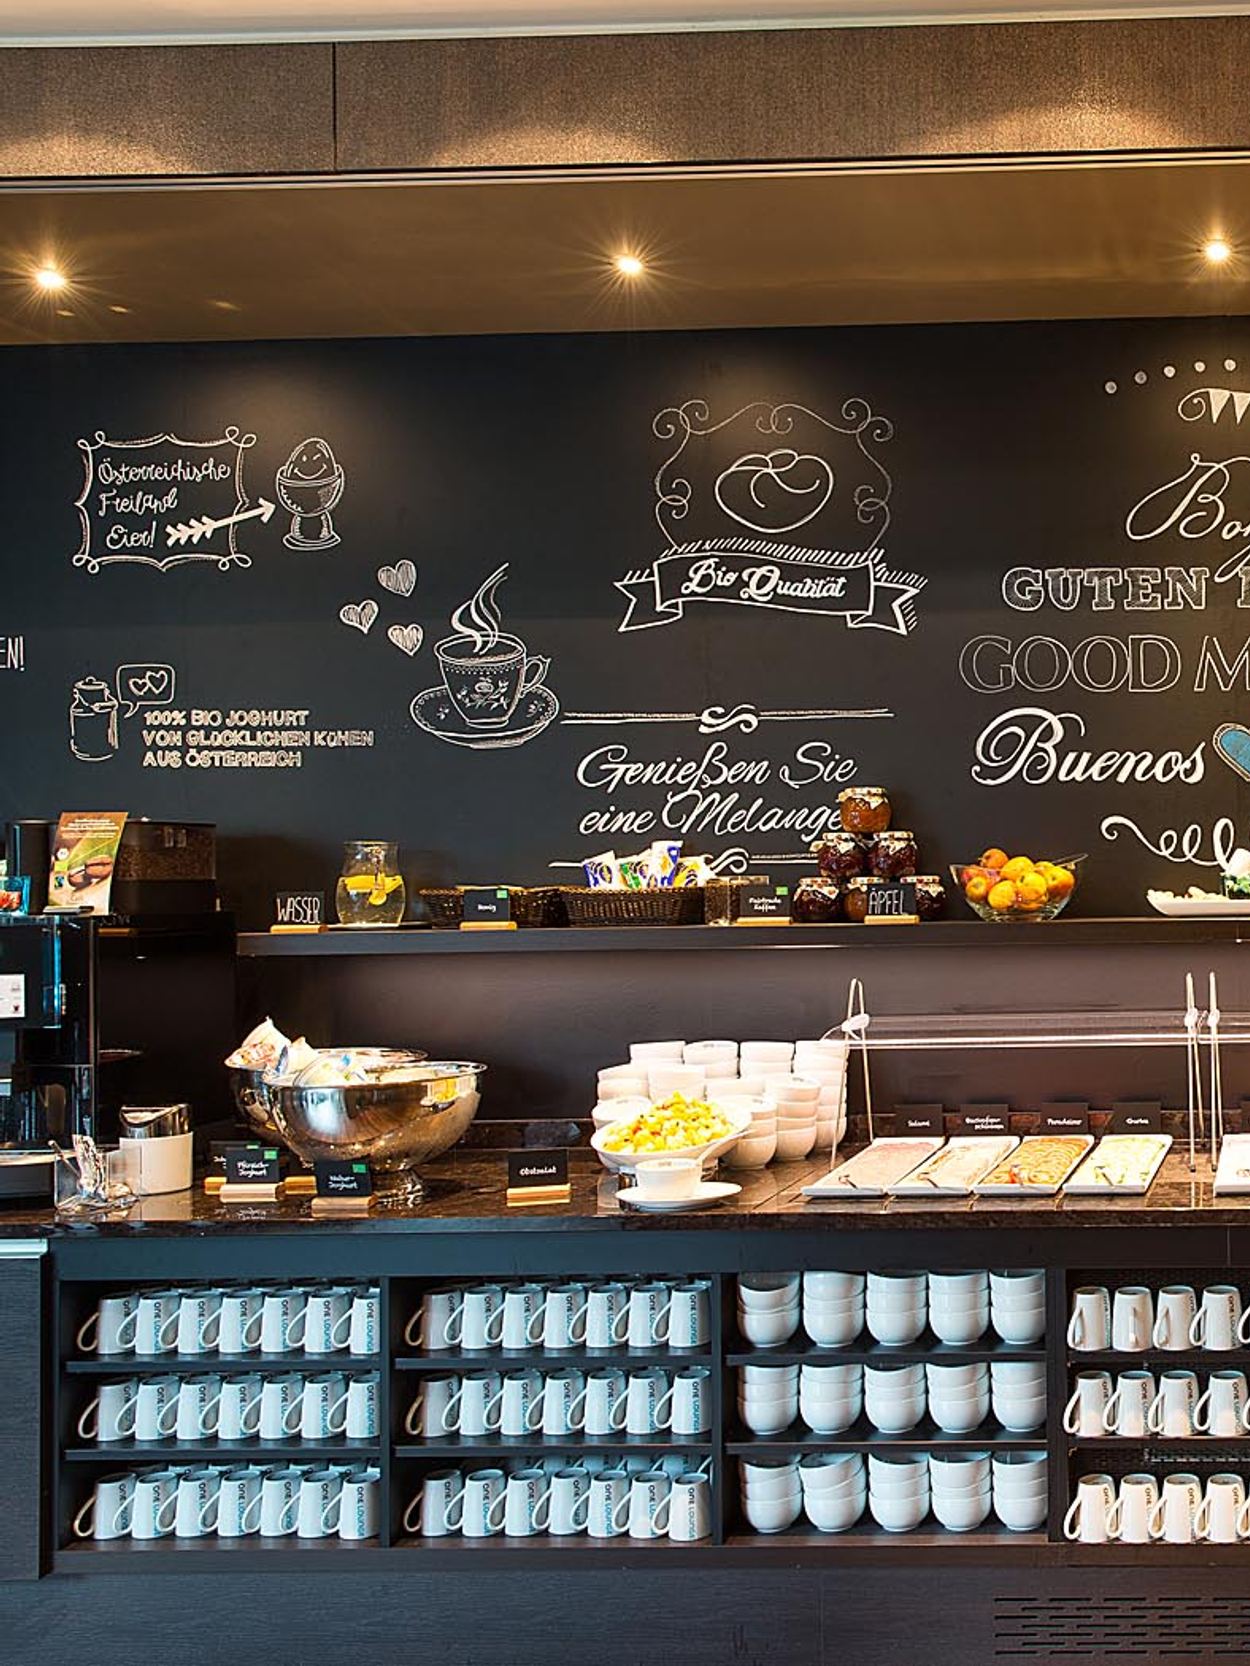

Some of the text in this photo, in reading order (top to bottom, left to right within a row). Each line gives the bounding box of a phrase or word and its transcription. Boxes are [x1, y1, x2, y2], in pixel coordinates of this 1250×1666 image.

[680, 556, 847, 602] Bio Qualität
[1001, 566, 1210, 612] GUTEN
[959, 634, 1182, 693] GOOD
[142, 729, 182, 746] VON
[144, 710, 187, 726] 100%
[191, 709, 222, 727] BIO
[142, 748, 301, 768] AUS ÖSTERREICH
[576, 741, 858, 793] Genießen Sie
[971, 707, 1206, 786] Buenos
[579, 789, 843, 843] eine Melange
[276, 896, 321, 924] WASSER
[868, 887, 906, 916] ÄPFEL
